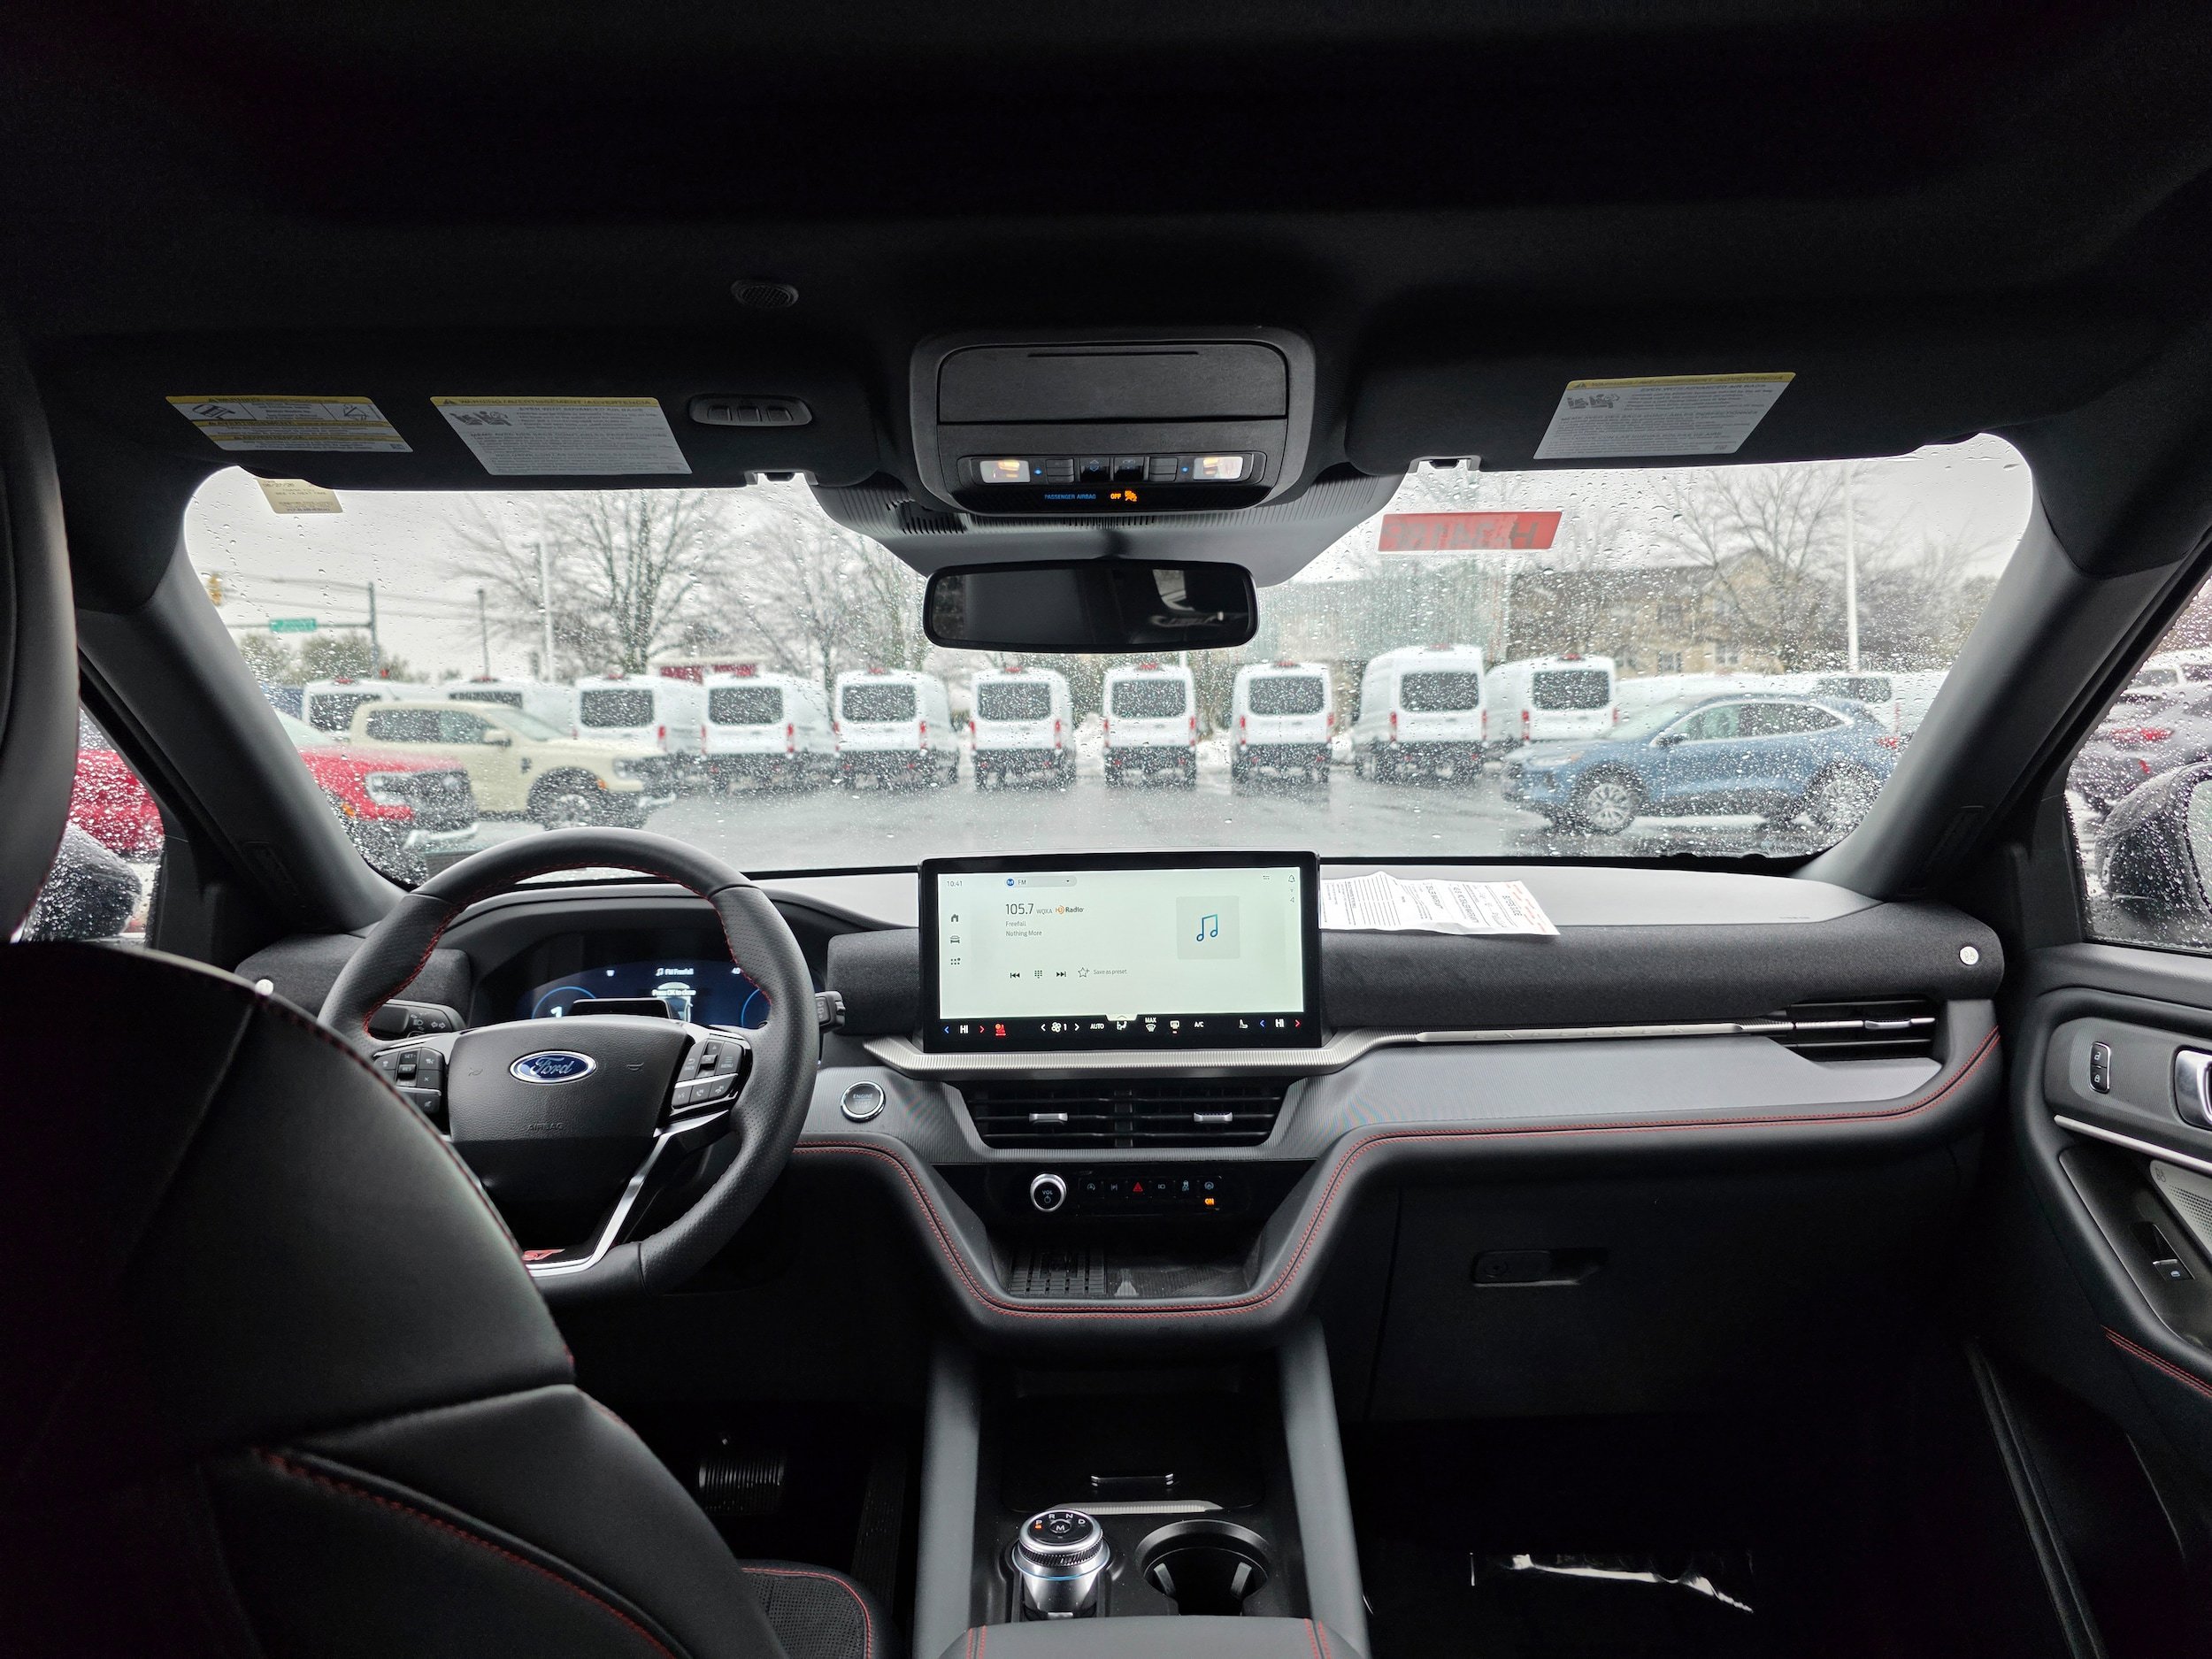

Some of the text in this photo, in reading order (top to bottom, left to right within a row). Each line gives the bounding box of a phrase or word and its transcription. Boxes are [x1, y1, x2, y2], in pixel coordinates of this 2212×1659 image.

[1005, 902, 1034, 915] 105.7
[959, 1024, 969, 1034] HI
[1275, 1018, 1285, 1028] HI
[530, 1056, 575, 1075] Ford
[522, 1248, 565, 1261] ST
